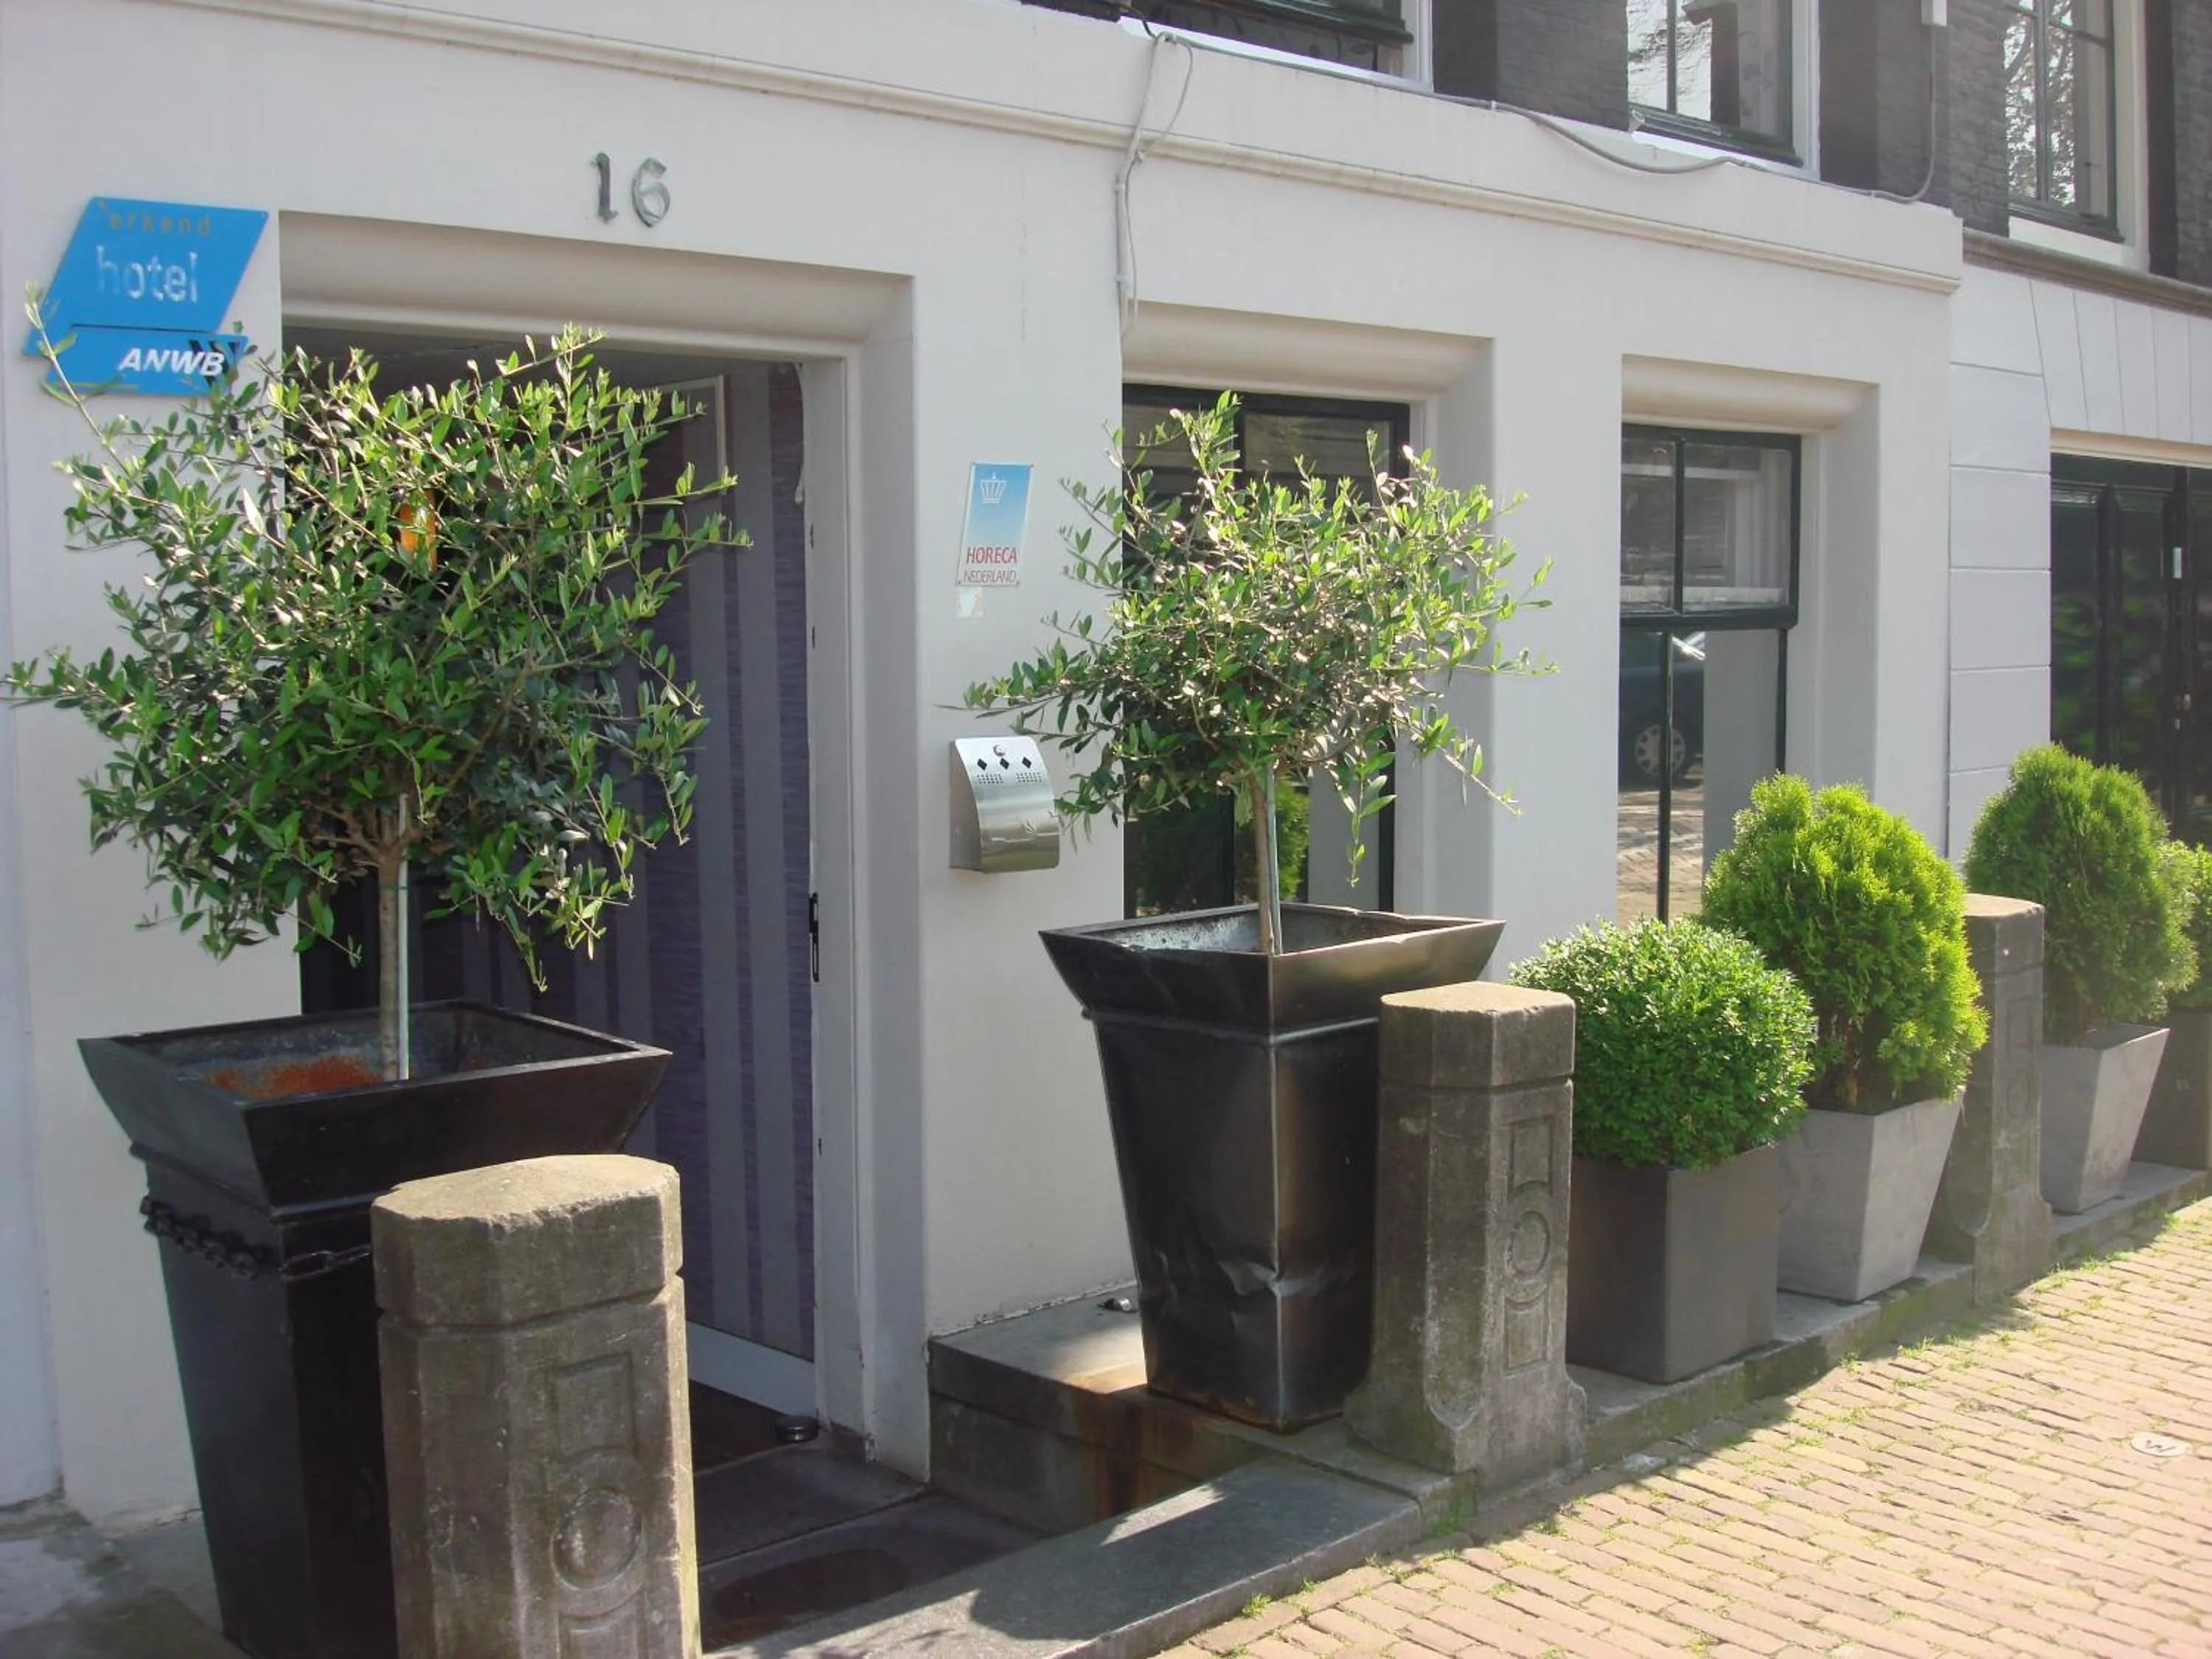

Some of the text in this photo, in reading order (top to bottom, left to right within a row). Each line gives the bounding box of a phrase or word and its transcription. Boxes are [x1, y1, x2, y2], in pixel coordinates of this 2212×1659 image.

[592, 153, 670, 228] 16
[96, 245, 198, 303] hotel
[118, 348, 226, 377] ANWB
[966, 546, 1018, 564] HORECA
[964, 569, 1017, 584] NEDERLAND
